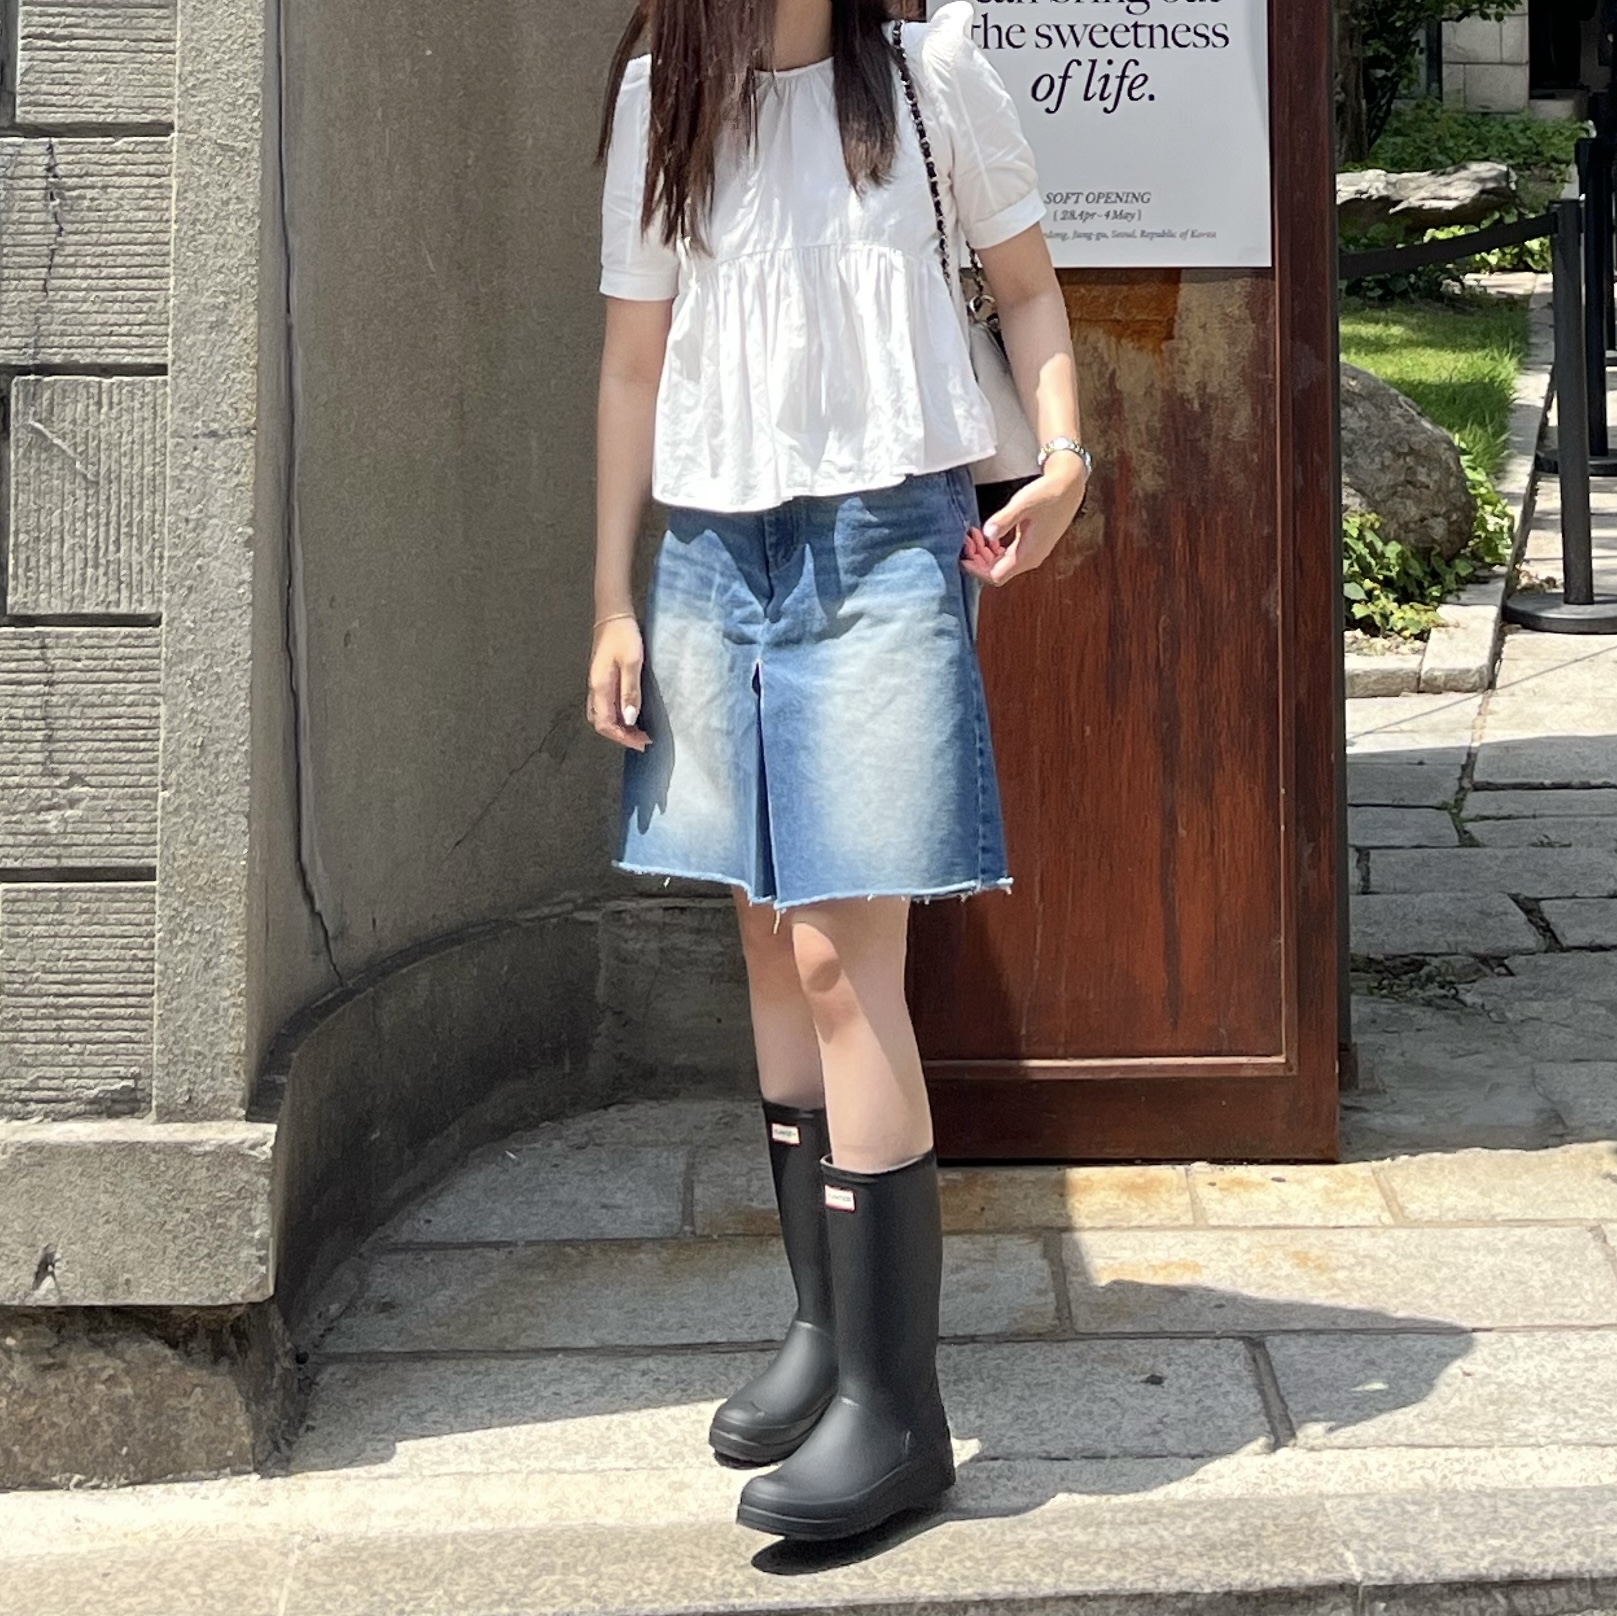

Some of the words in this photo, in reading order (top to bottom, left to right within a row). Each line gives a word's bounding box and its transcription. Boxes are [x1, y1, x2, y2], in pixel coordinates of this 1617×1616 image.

[1035, 20, 1230, 50] sweetness
[1030, 58, 1082, 115] of
[1083, 58, 1155, 115] life.
[1043, 191, 1084, 205] SOFT
[1085, 191, 1152, 205] OPENING
